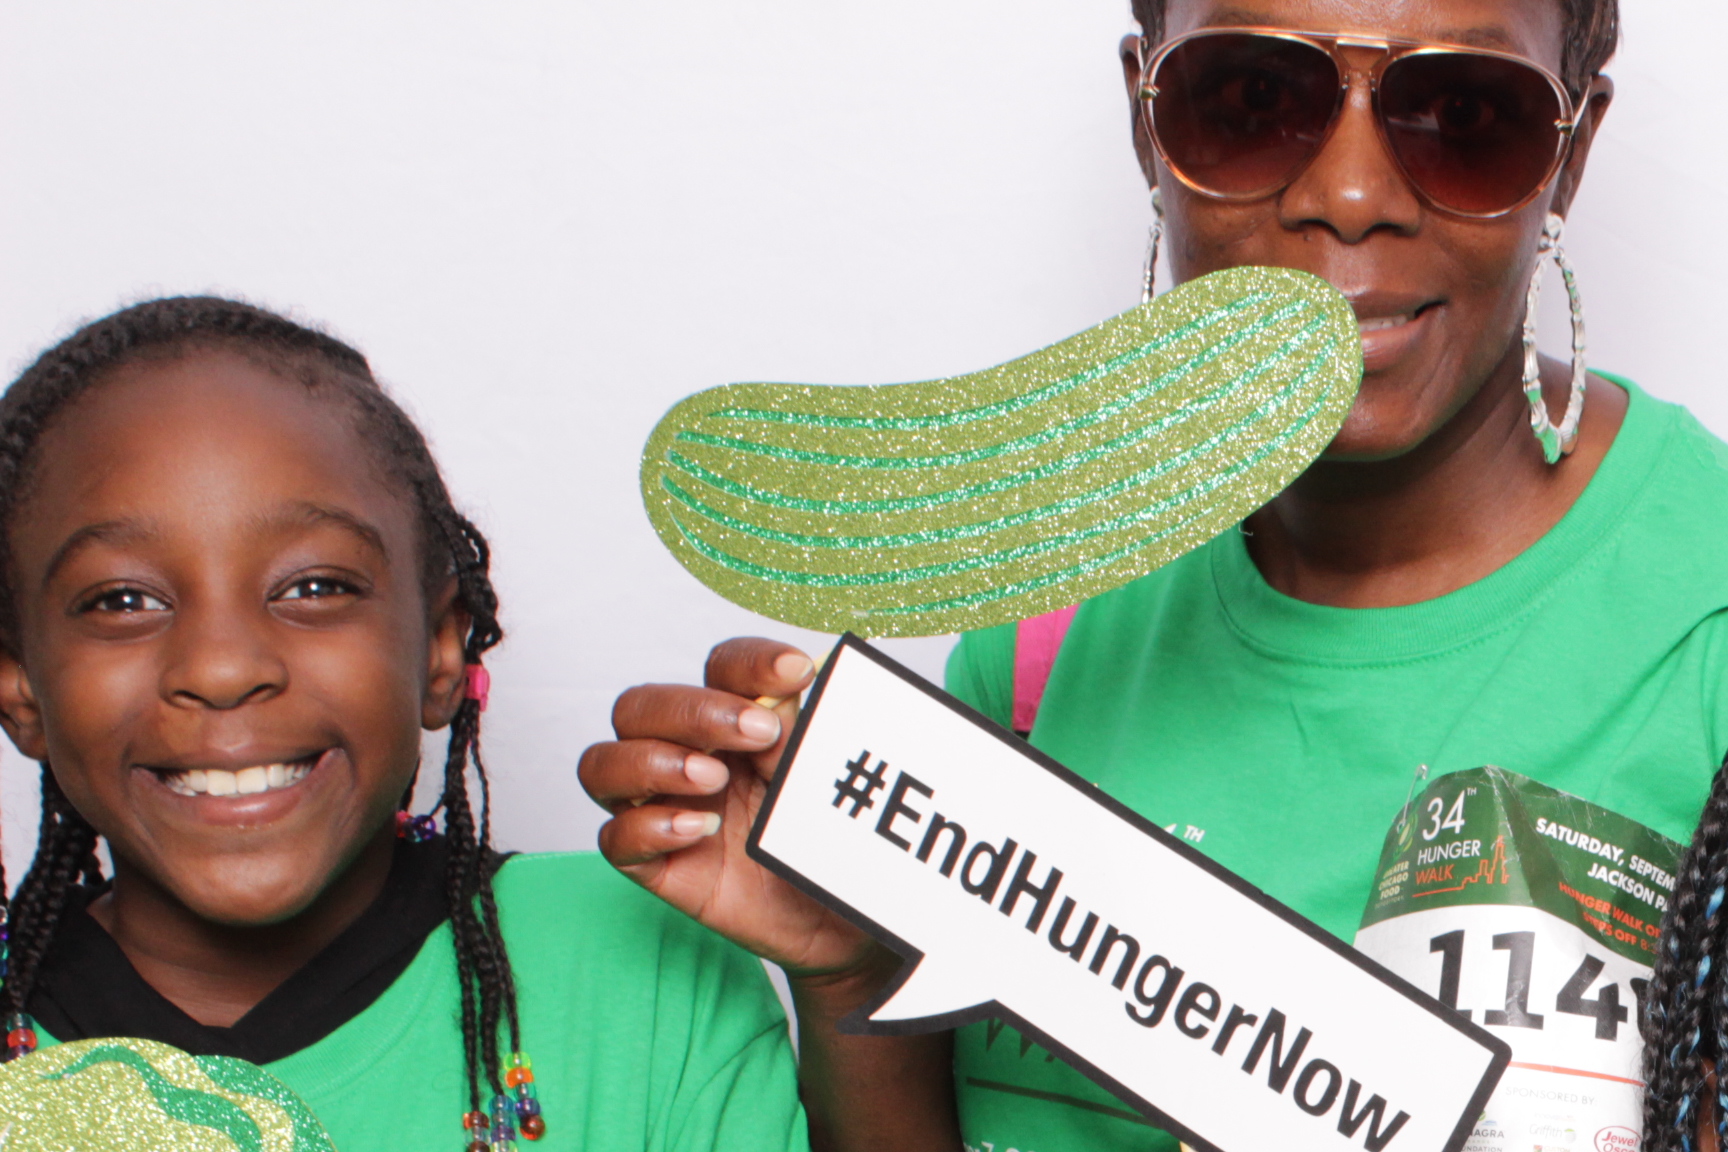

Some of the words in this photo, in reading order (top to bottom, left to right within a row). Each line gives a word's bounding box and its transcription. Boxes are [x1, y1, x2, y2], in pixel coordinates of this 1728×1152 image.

[1417, 839, 1481, 866] HUNGER
[1535, 817, 1625, 867] SATURDAY,
[1628, 854, 1676, 892] SEPTEM
[1415, 863, 1455, 886] WALK
[1587, 862, 1656, 906] JACKSON
[1558, 881, 1613, 915] HUNGER
[1612, 906, 1644, 932] WALK
[1582, 911, 1614, 937] STEPS
[1614, 929, 1638, 946] OFF
[1429, 928, 1652, 1043] 114
[1505, 1086, 1579, 1104] SPONSORED
[1471, 1128, 1505, 1139] AGRA
[1601, 1131, 1639, 1148] Jewel
